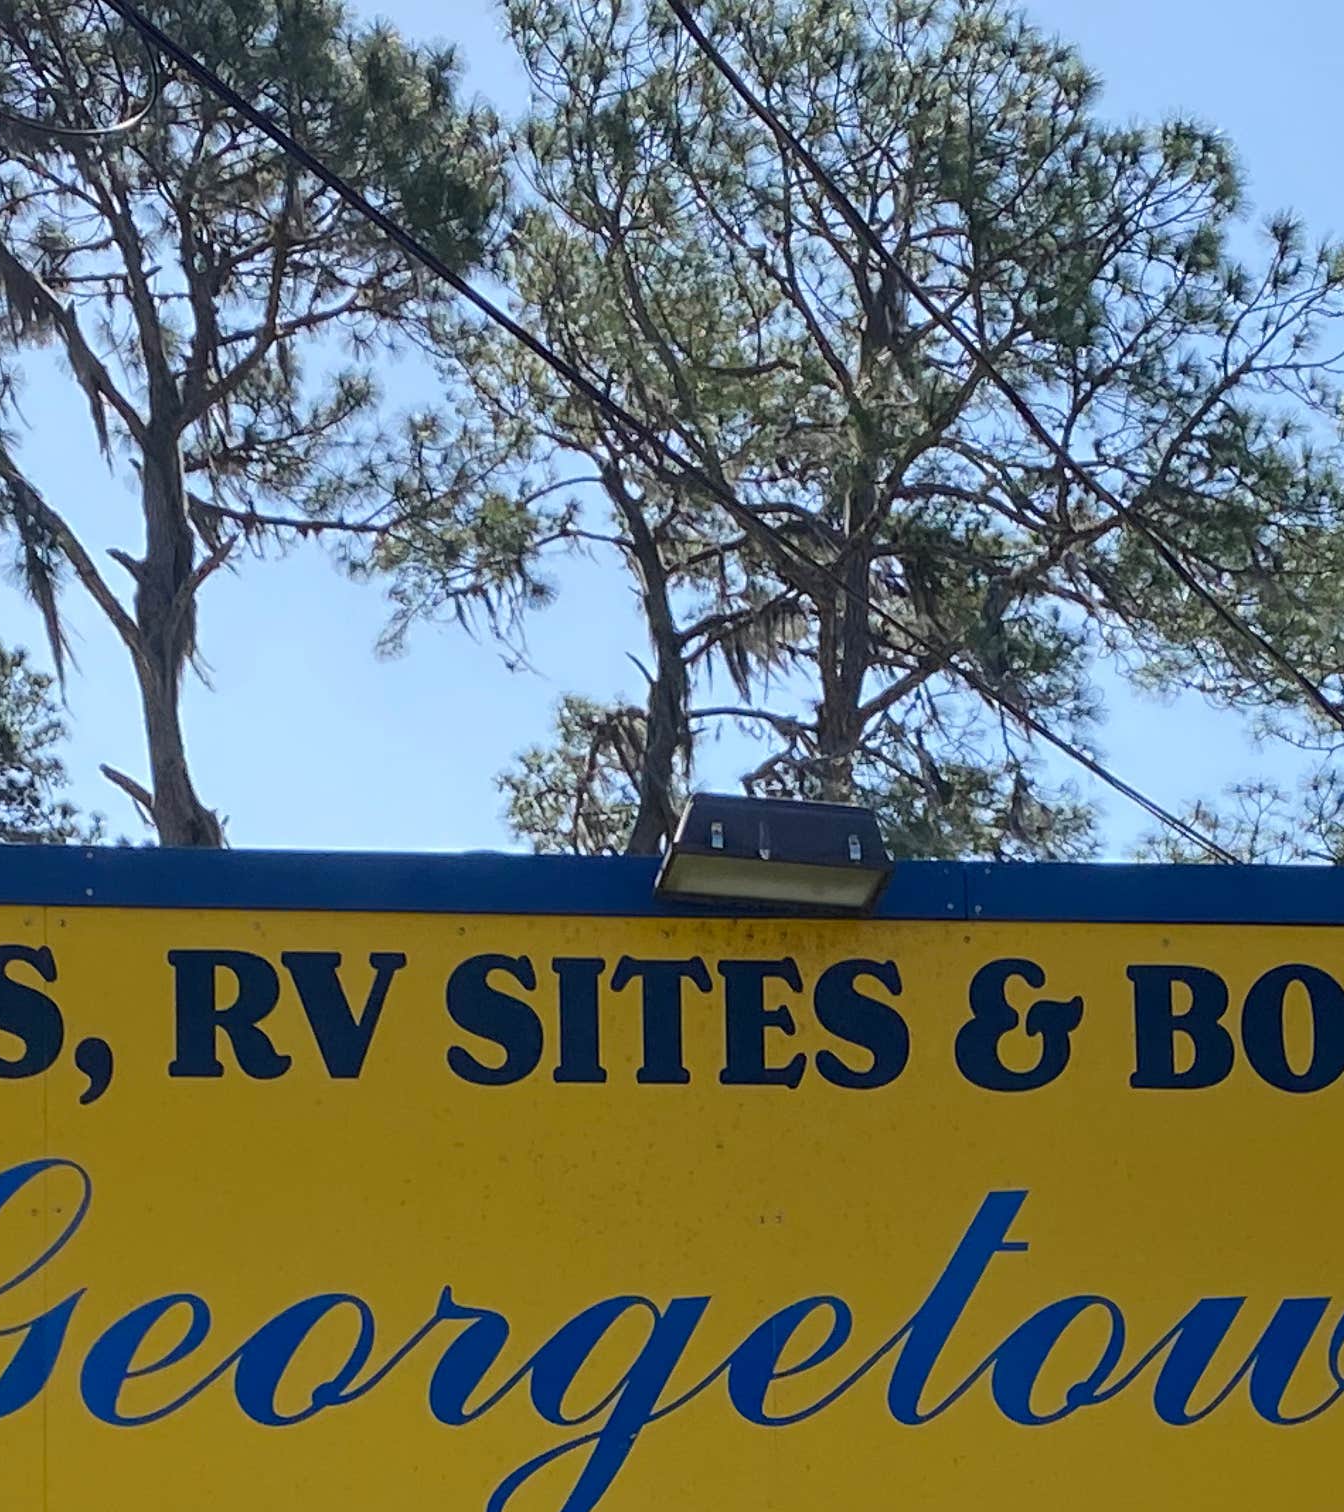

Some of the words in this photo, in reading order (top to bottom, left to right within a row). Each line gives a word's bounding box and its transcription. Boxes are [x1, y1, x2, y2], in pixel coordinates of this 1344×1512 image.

[168, 949, 408, 1080] RV
[445, 953, 910, 1091] SITES
[954, 958, 1084, 1092] &
